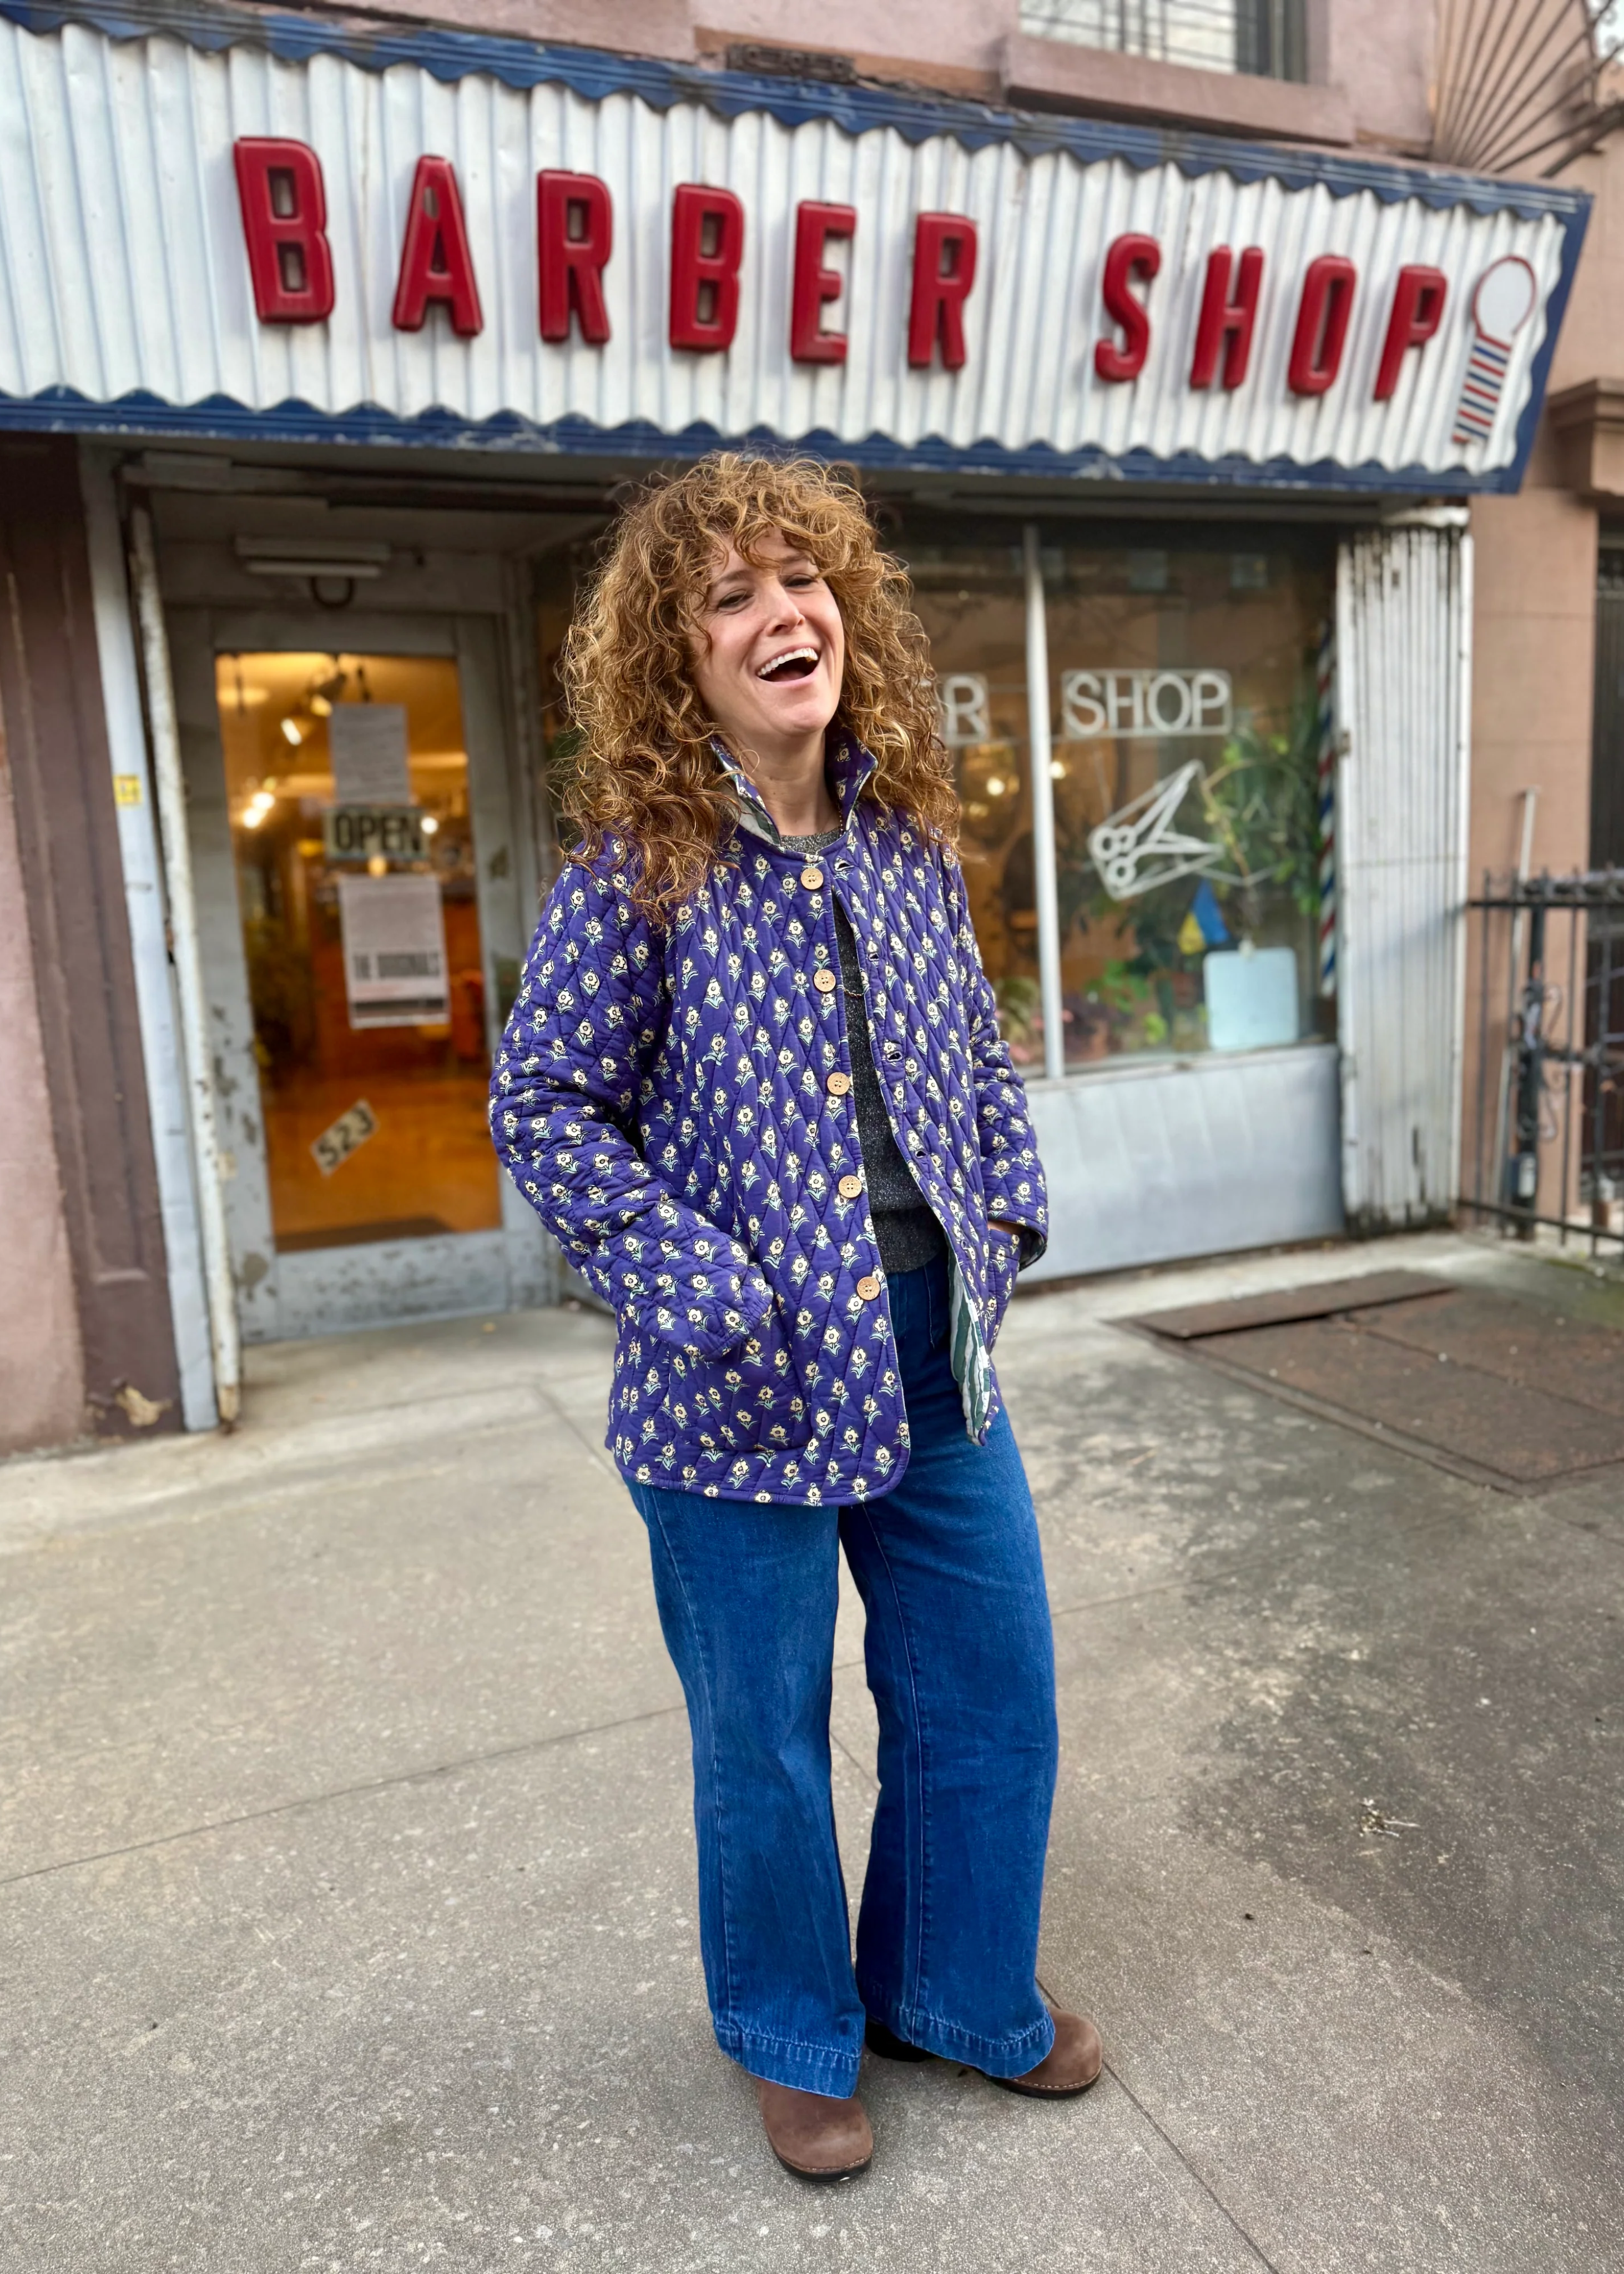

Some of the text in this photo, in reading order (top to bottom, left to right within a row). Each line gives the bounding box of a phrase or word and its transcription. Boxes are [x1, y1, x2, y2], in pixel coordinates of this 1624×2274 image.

[233, 137, 1447, 400] BARBER SHOP
[1065, 672, 1229, 736] SHOP
[335, 814, 422, 852] OPEN
[317, 1106, 375, 1168] 523
